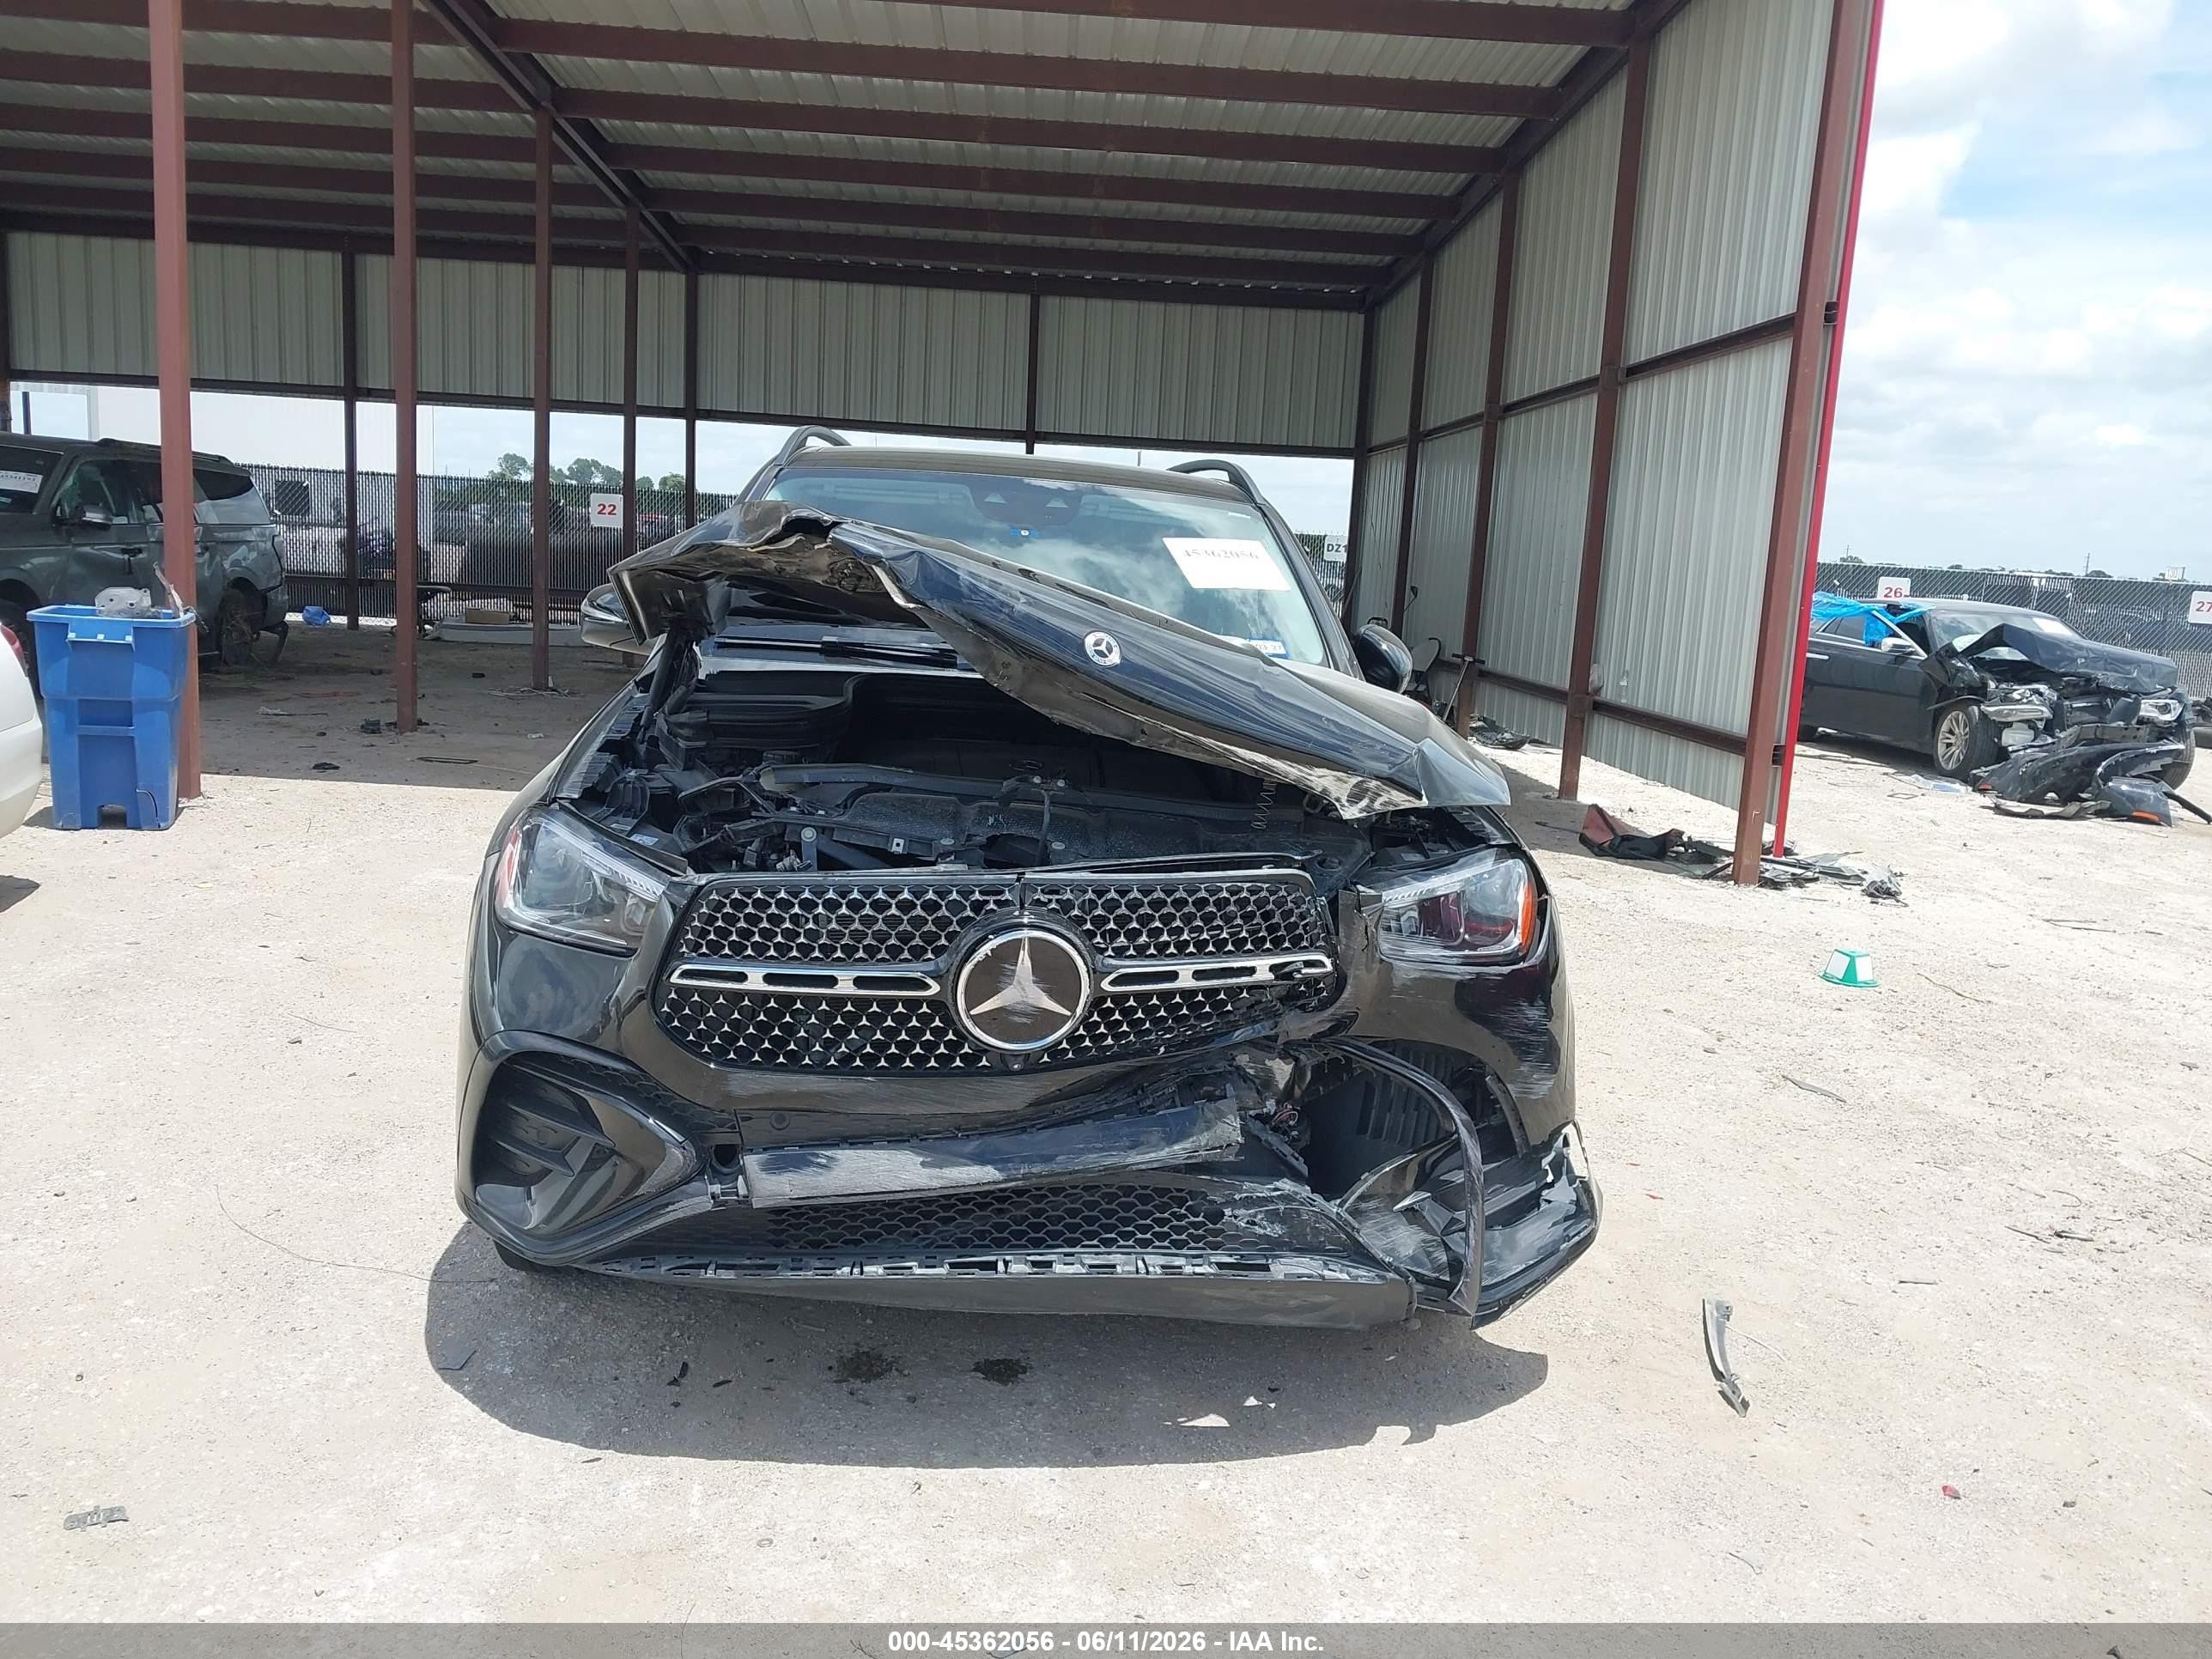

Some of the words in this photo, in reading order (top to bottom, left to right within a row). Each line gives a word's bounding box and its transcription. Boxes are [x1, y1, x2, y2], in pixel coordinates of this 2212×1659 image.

[597, 503, 617, 516] 22
[1883, 586, 1904, 599] 26
[2195, 600, 2212, 613] 27
